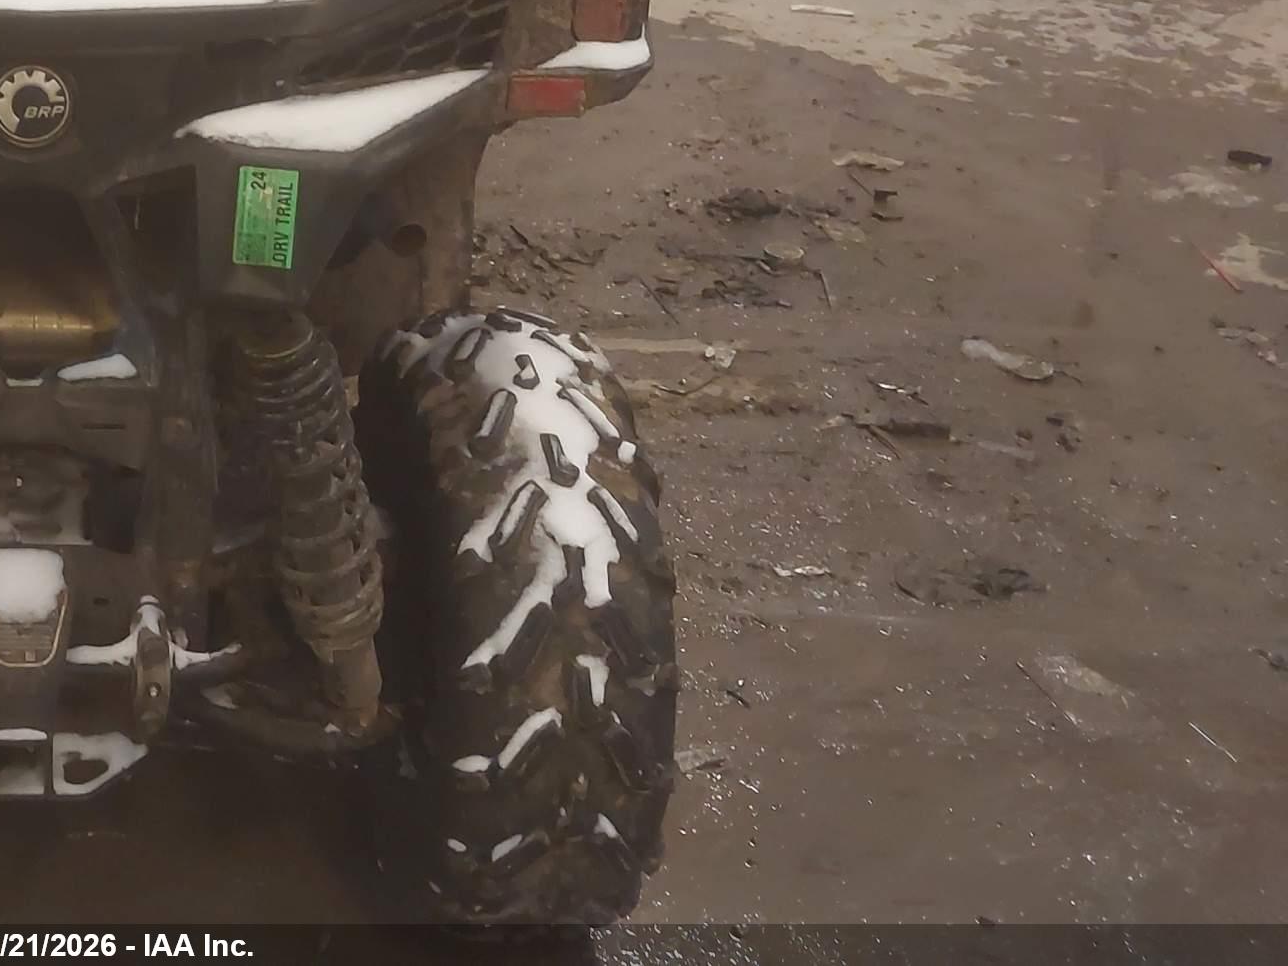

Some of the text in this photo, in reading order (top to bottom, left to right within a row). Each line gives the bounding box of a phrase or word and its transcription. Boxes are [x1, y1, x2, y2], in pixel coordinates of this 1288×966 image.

[24, 105, 65, 119] BRP
[250, 171, 266, 191] 24
[275, 182, 293, 226] TRAIL
